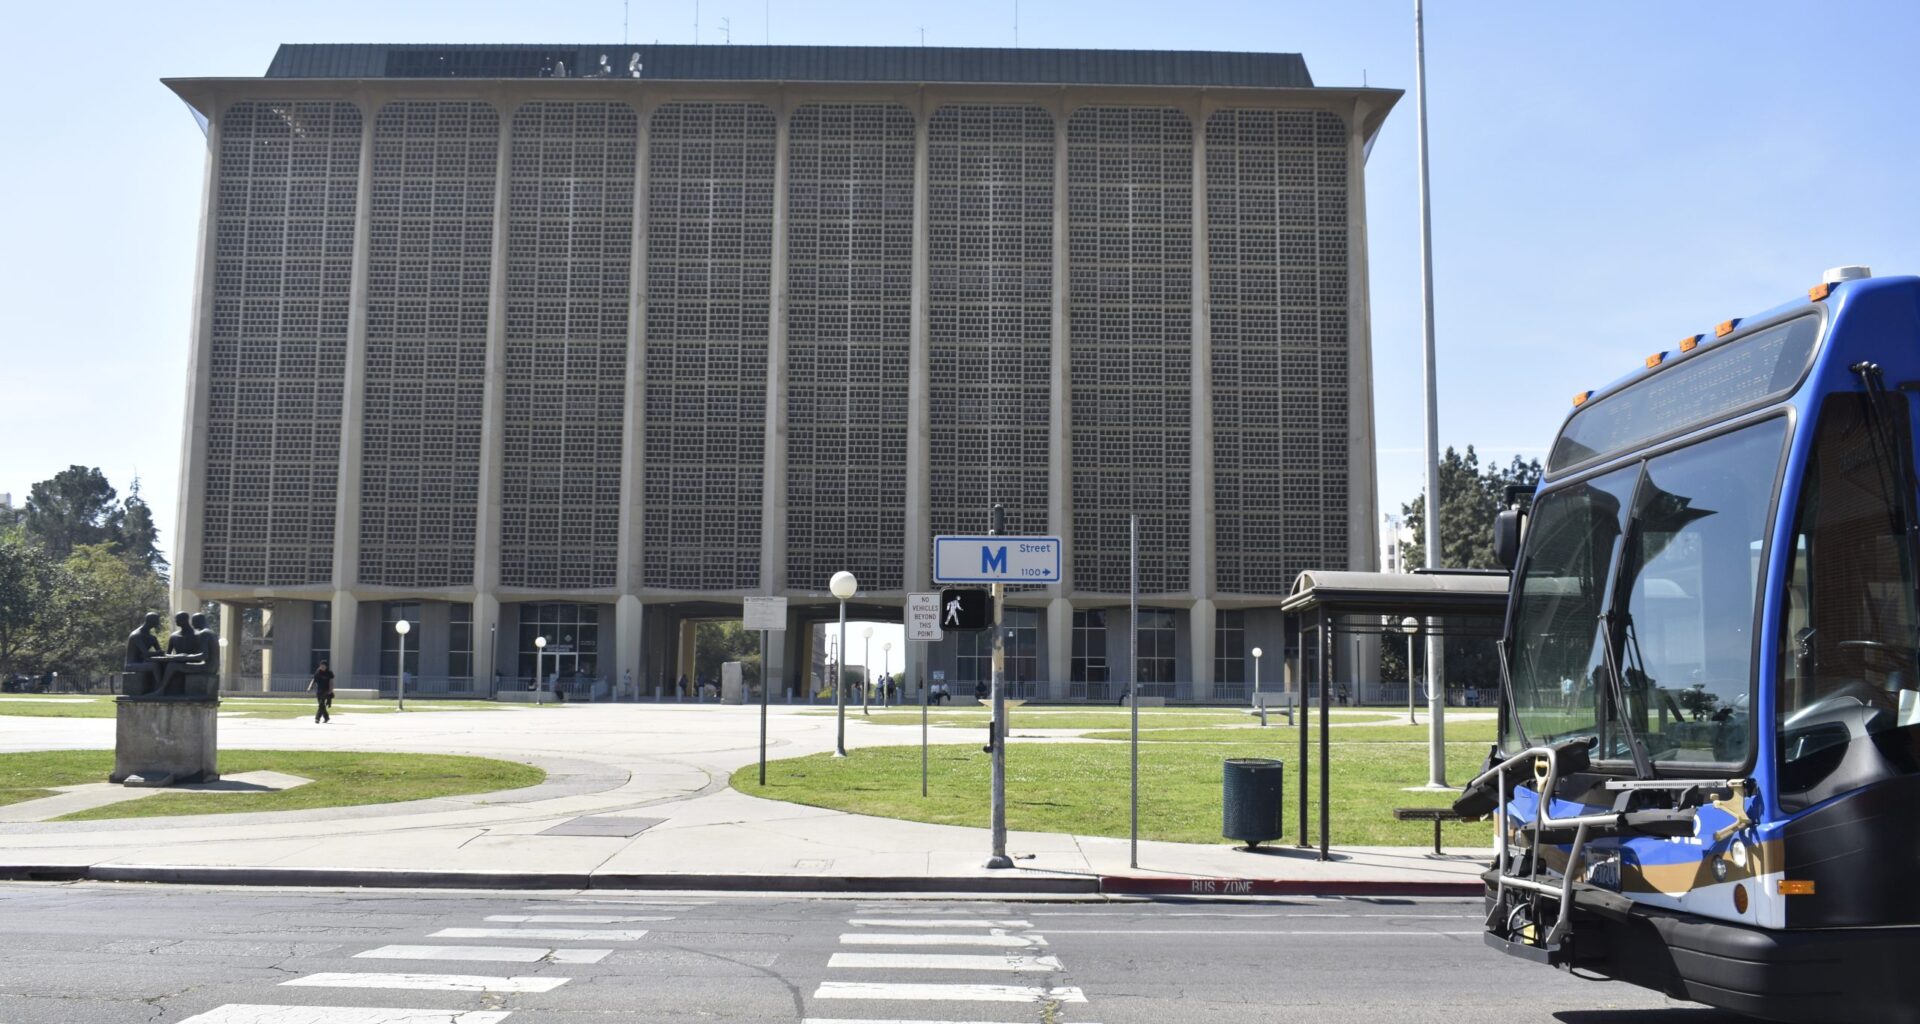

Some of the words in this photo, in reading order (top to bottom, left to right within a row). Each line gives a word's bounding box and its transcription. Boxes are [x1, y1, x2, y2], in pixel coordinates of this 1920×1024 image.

[982, 546, 1007, 573] M
[1020, 544, 1051, 552] Street
[1021, 568, 1040, 576] 1100
[1191, 880, 1216, 893] BUS
[1223, 881, 1254, 894] ZONE
